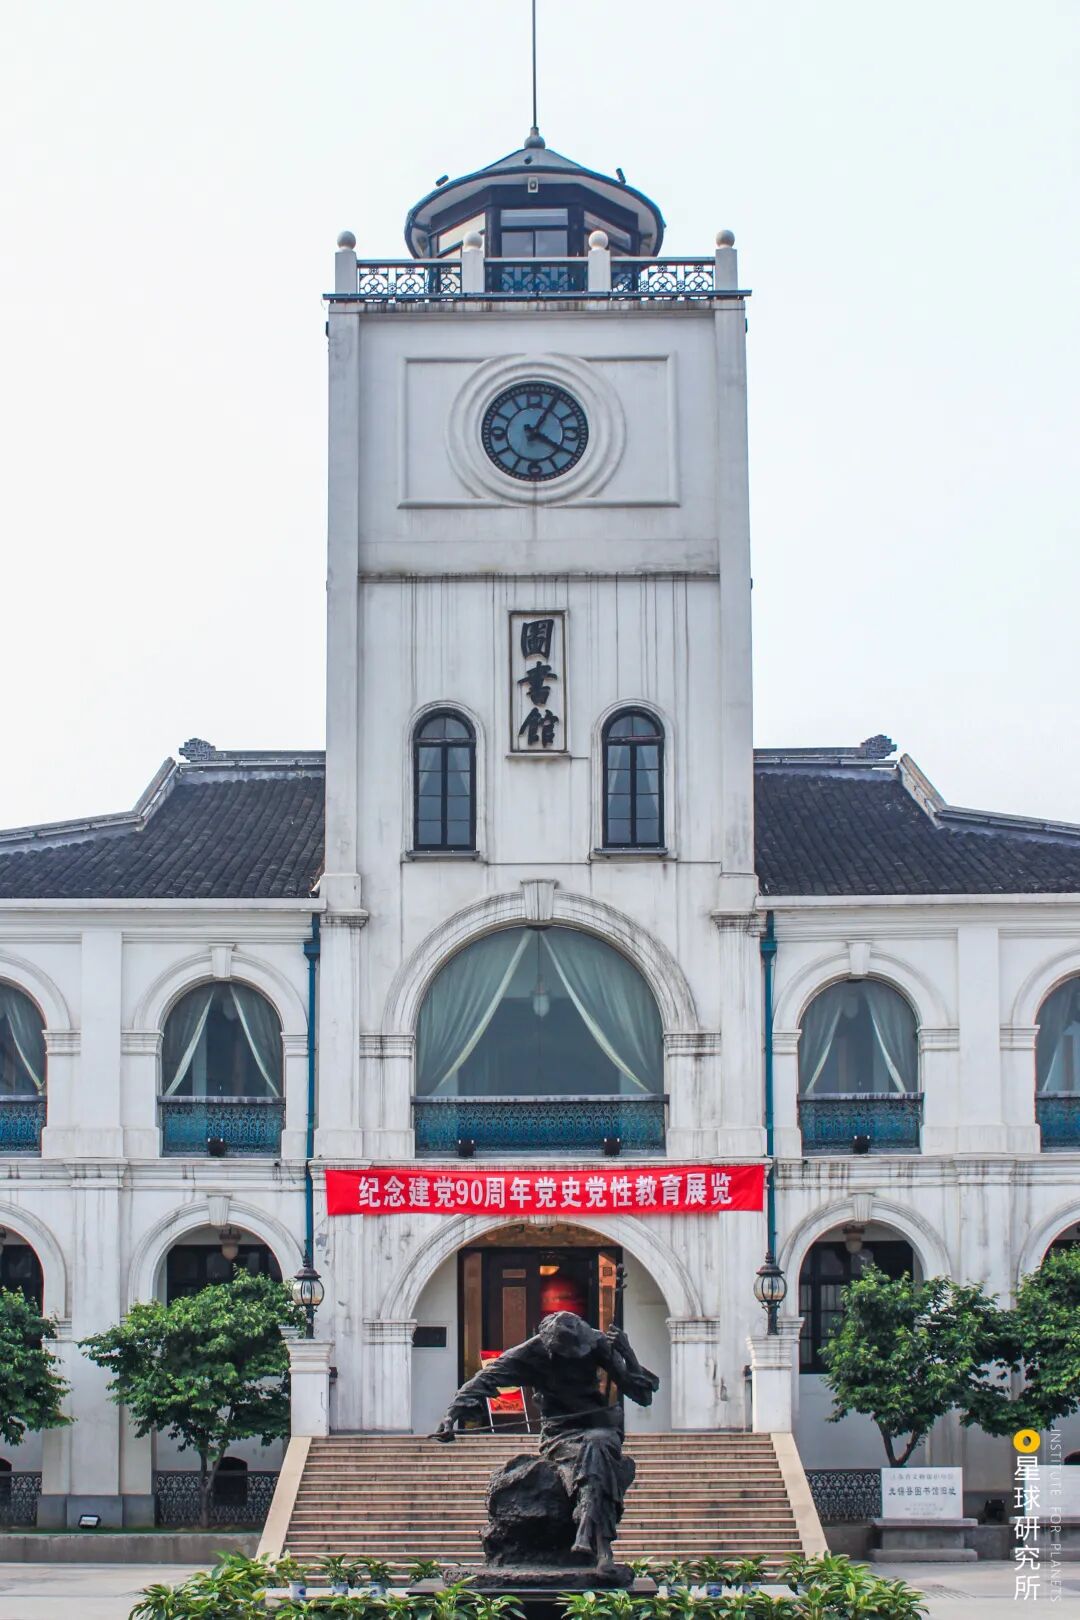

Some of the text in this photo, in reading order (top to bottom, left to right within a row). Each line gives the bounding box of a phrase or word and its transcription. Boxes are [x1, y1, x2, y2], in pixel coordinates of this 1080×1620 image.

[358, 1173, 733, 1209] 纪念建党90周年党史党性教育展览
